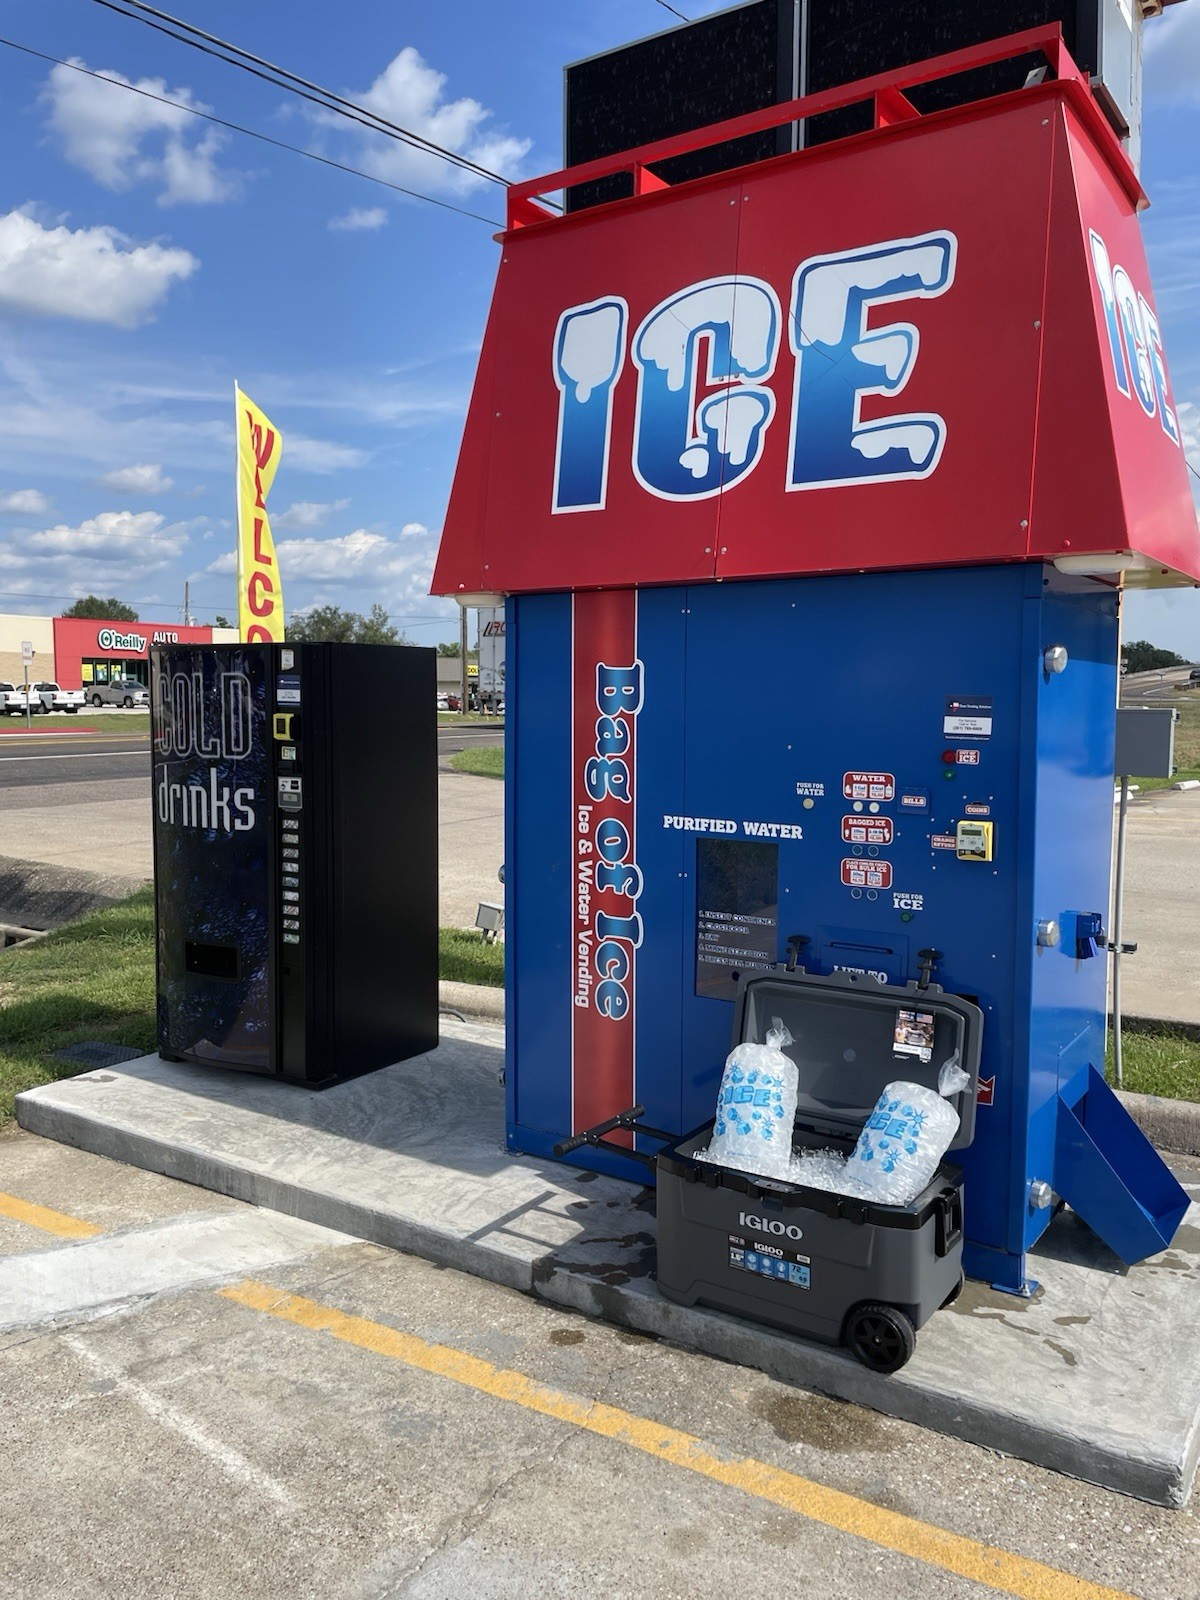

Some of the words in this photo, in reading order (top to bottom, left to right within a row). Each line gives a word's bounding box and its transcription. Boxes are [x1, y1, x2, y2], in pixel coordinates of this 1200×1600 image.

[1089, 228, 1180, 448] ICE
[551, 229, 958, 515] ICE
[100, 630, 146, 651] O'Reilly
[153, 631, 178, 643] AUTO
[158, 672, 253, 759] COLD
[584, 658, 644, 803] Bag
[959, 754, 976, 763] ICE
[159, 764, 255, 832] drinks
[796, 788, 824, 796] WATER
[903, 797, 924, 805] BILLS
[578, 804, 593, 834] Ice
[663, 815, 738, 834] PURIFIED
[742, 821, 804, 840] WATER
[578, 838, 593, 855] &
[578, 860, 593, 926] Water
[893, 898, 923, 910] ICE
[575, 930, 593, 1008] Vending
[595, 910, 644, 1020] Ice
[724, 1085, 771, 1106] ICE
[866, 1112, 908, 1140] ICE
[739, 1211, 803, 1240] IGLOO
[754, 1242, 784, 1256] IGLOO
